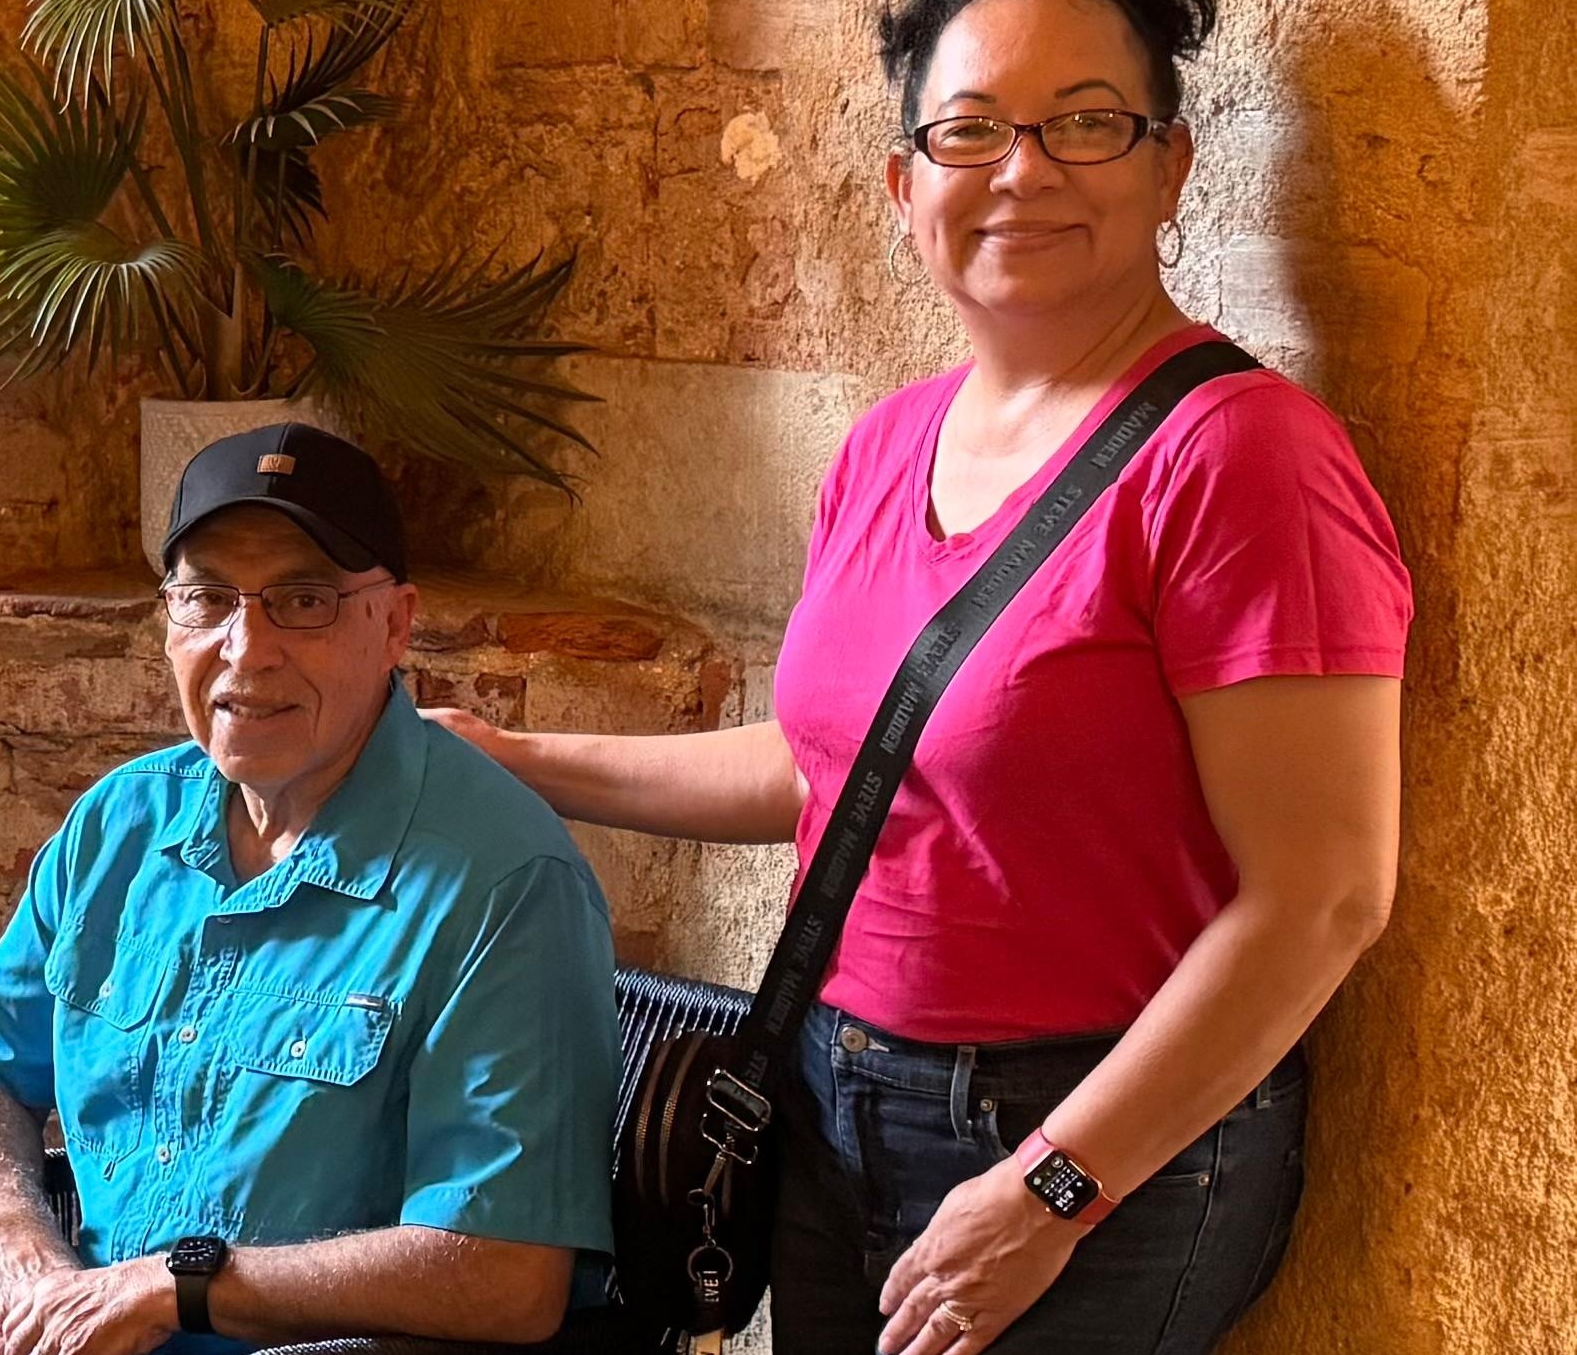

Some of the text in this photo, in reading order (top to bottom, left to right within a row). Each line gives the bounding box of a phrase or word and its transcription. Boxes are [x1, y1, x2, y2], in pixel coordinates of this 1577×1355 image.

[1089, 401, 1160, 469] MADDEN
[970, 486, 1084, 609] STEVE MADDEN
[879, 681, 926, 755] MADDEN
[848, 770, 883, 828] STEVE
